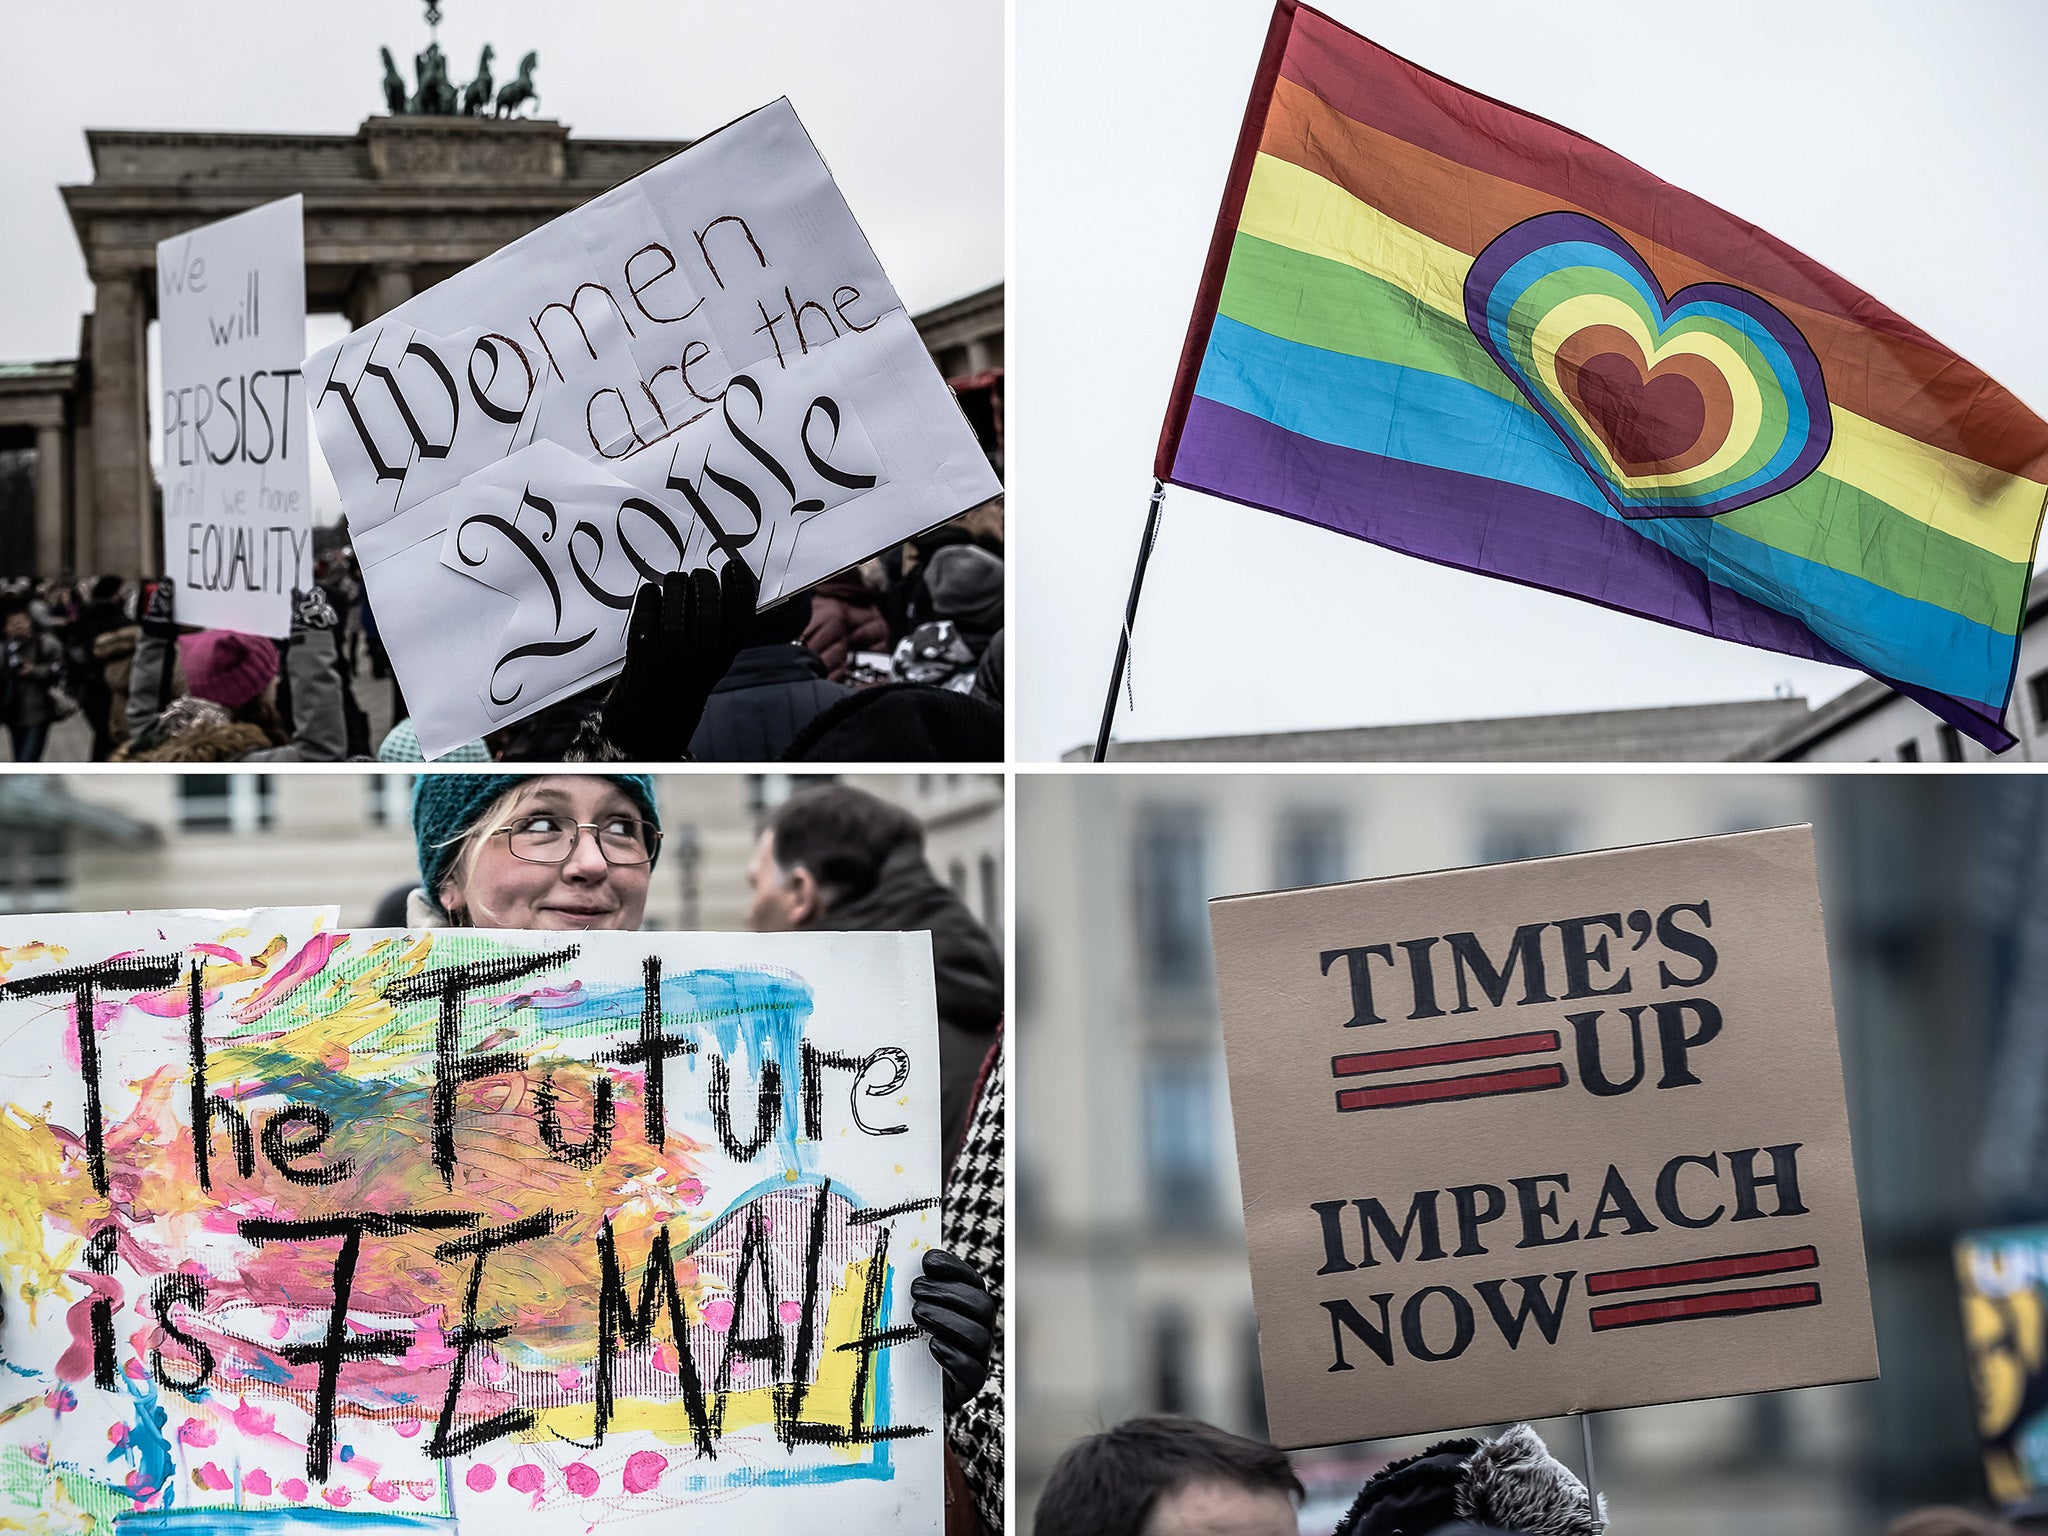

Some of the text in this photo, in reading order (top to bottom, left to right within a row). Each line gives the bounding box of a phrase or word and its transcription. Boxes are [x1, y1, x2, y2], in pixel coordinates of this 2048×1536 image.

[158, 235, 208, 297] We
[208, 268, 259, 346] will
[164, 368, 302, 467] PERSIST
[317, 214, 770, 513] Women
[586, 285, 882, 461] are the
[222, 486, 247, 515] we
[258, 468, 300, 514] have
[456, 374, 877, 705] People
[187, 524, 310, 595] EQUALITY
[1319, 899, 1719, 1029] TIME'S
[0, 944, 912, 1196] The Future
[1564, 997, 1723, 1097] UP
[1310, 1142, 1810, 1276] IMPEACH
[83, 1178, 942, 1484] is FEMALE
[1319, 1270, 1578, 1372] NOW
